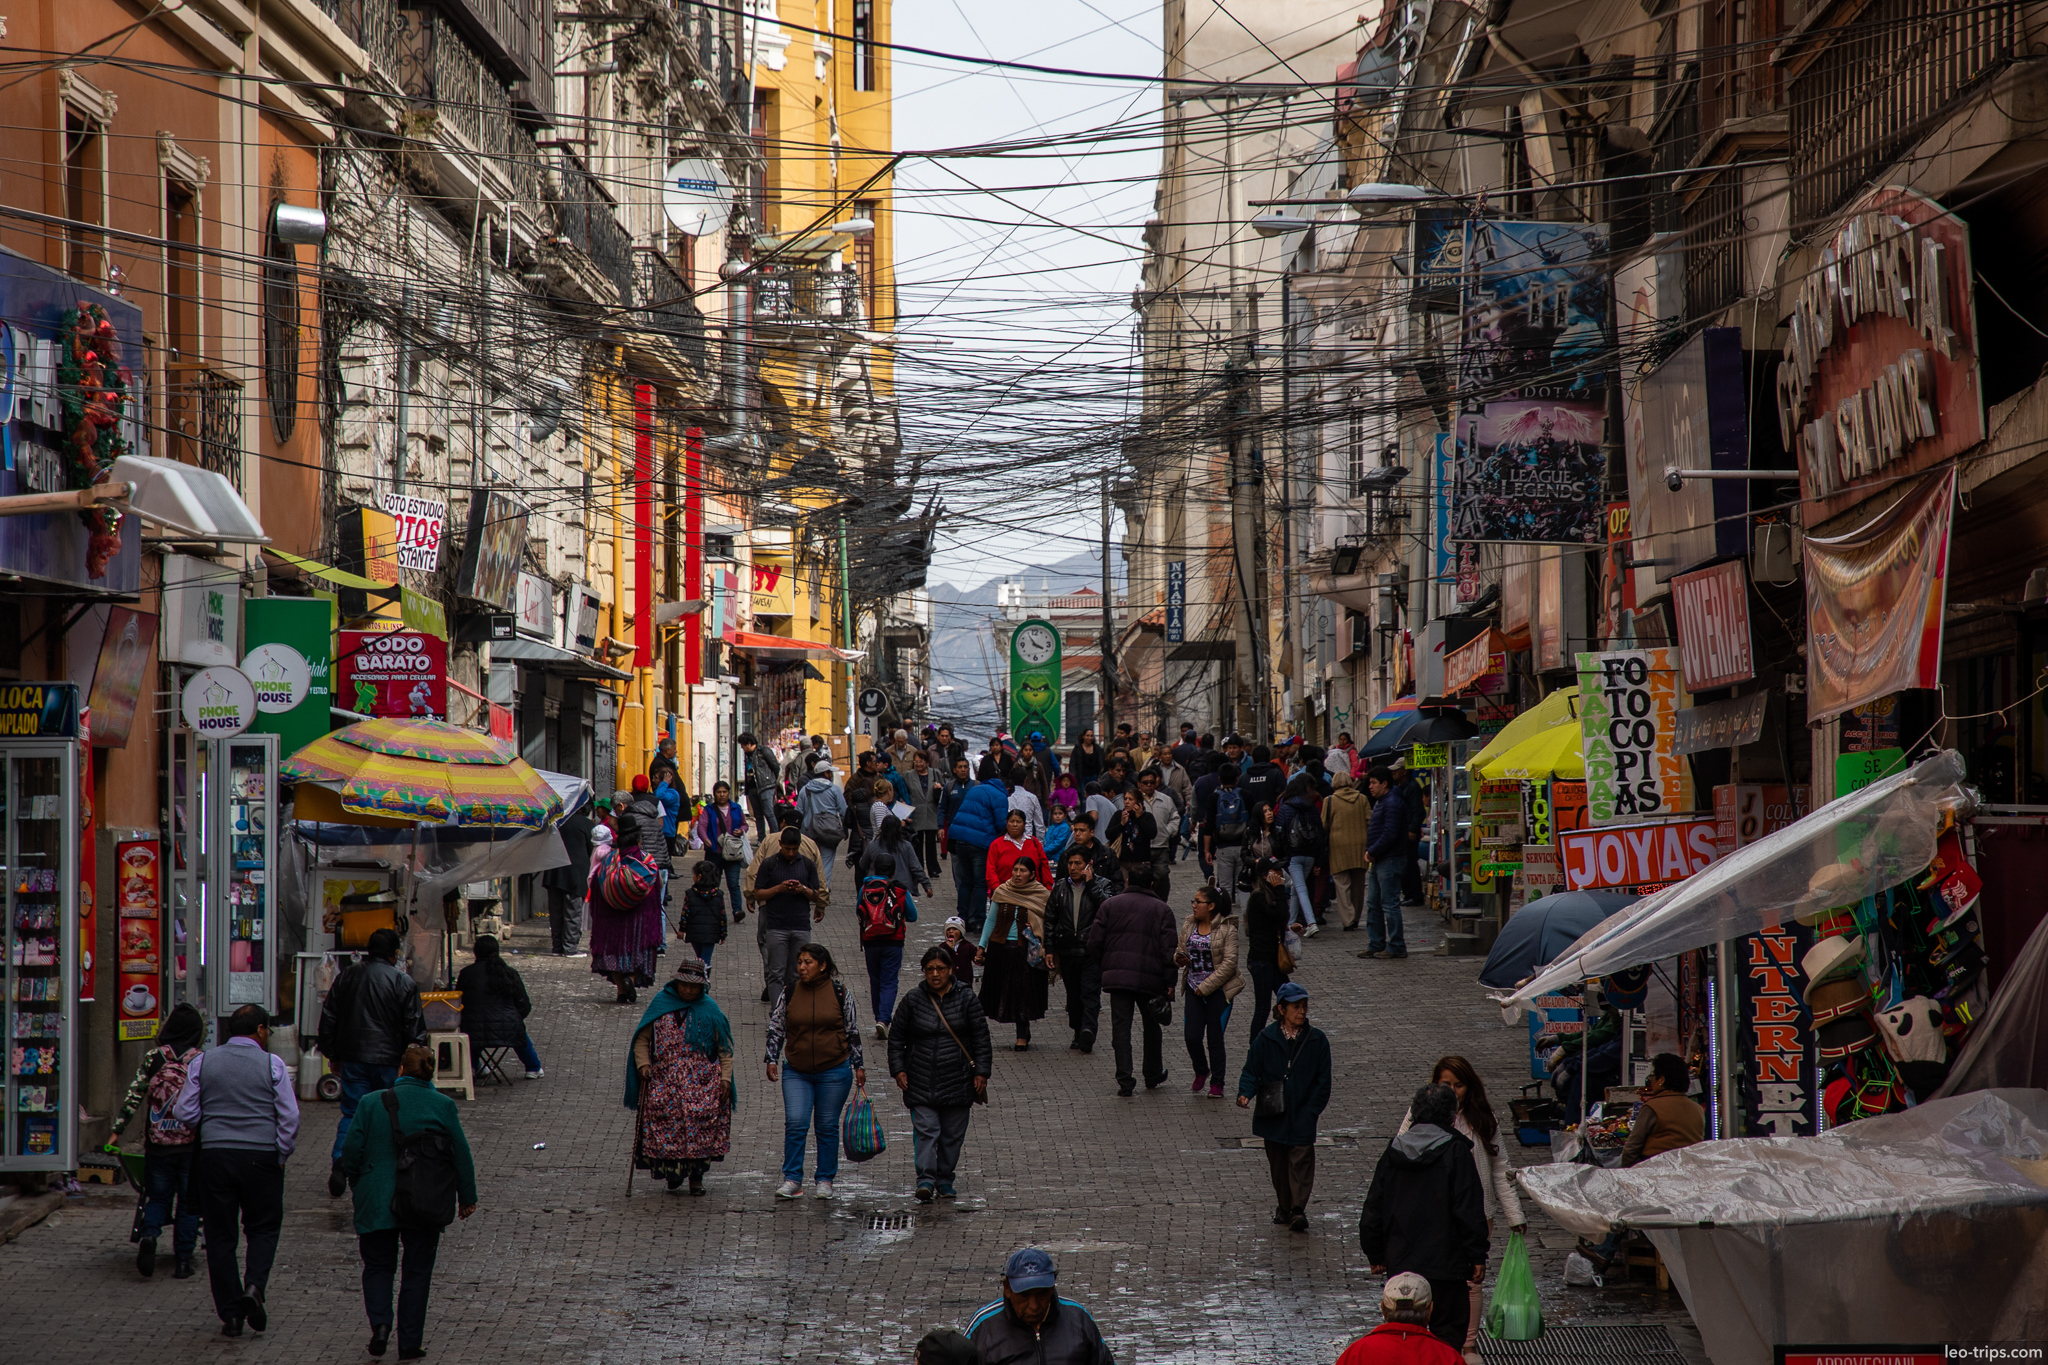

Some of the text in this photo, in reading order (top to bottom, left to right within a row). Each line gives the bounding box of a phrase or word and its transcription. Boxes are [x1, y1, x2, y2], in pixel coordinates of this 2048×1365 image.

[1524, 386, 1591, 399] DOTA 2
[1510, 469, 1571, 483] LEAGUE
[1500, 479, 1586, 502] LEGENDS
[384, 494, 444, 519] FOTO ESTUDIO
[1170, 562, 1183, 628] NOTARIA
[1677, 571, 1743, 685] JOYERIA
[362, 637, 425, 653] TODO
[356, 655, 431, 671] BARATO
[255, 681, 292, 692] PHONE
[199, 705, 239, 718] PHONE
[199, 717, 240, 729] HOUSE
[1577, 653, 1615, 820] LLAMADAS
[1864, 759, 1882, 774] SE
[1569, 825, 1717, 886] JOYAS
[1527, 873, 1546, 885] VENTA
[1547, 873, 1556, 885] DE
[1536, 995, 1566, 1008] CARGADOR
[1545, 1022, 1562, 1033] FLASH
[1749, 910, 1810, 1137] INTERNET
[160, 1119, 184, 1130] NIKE
